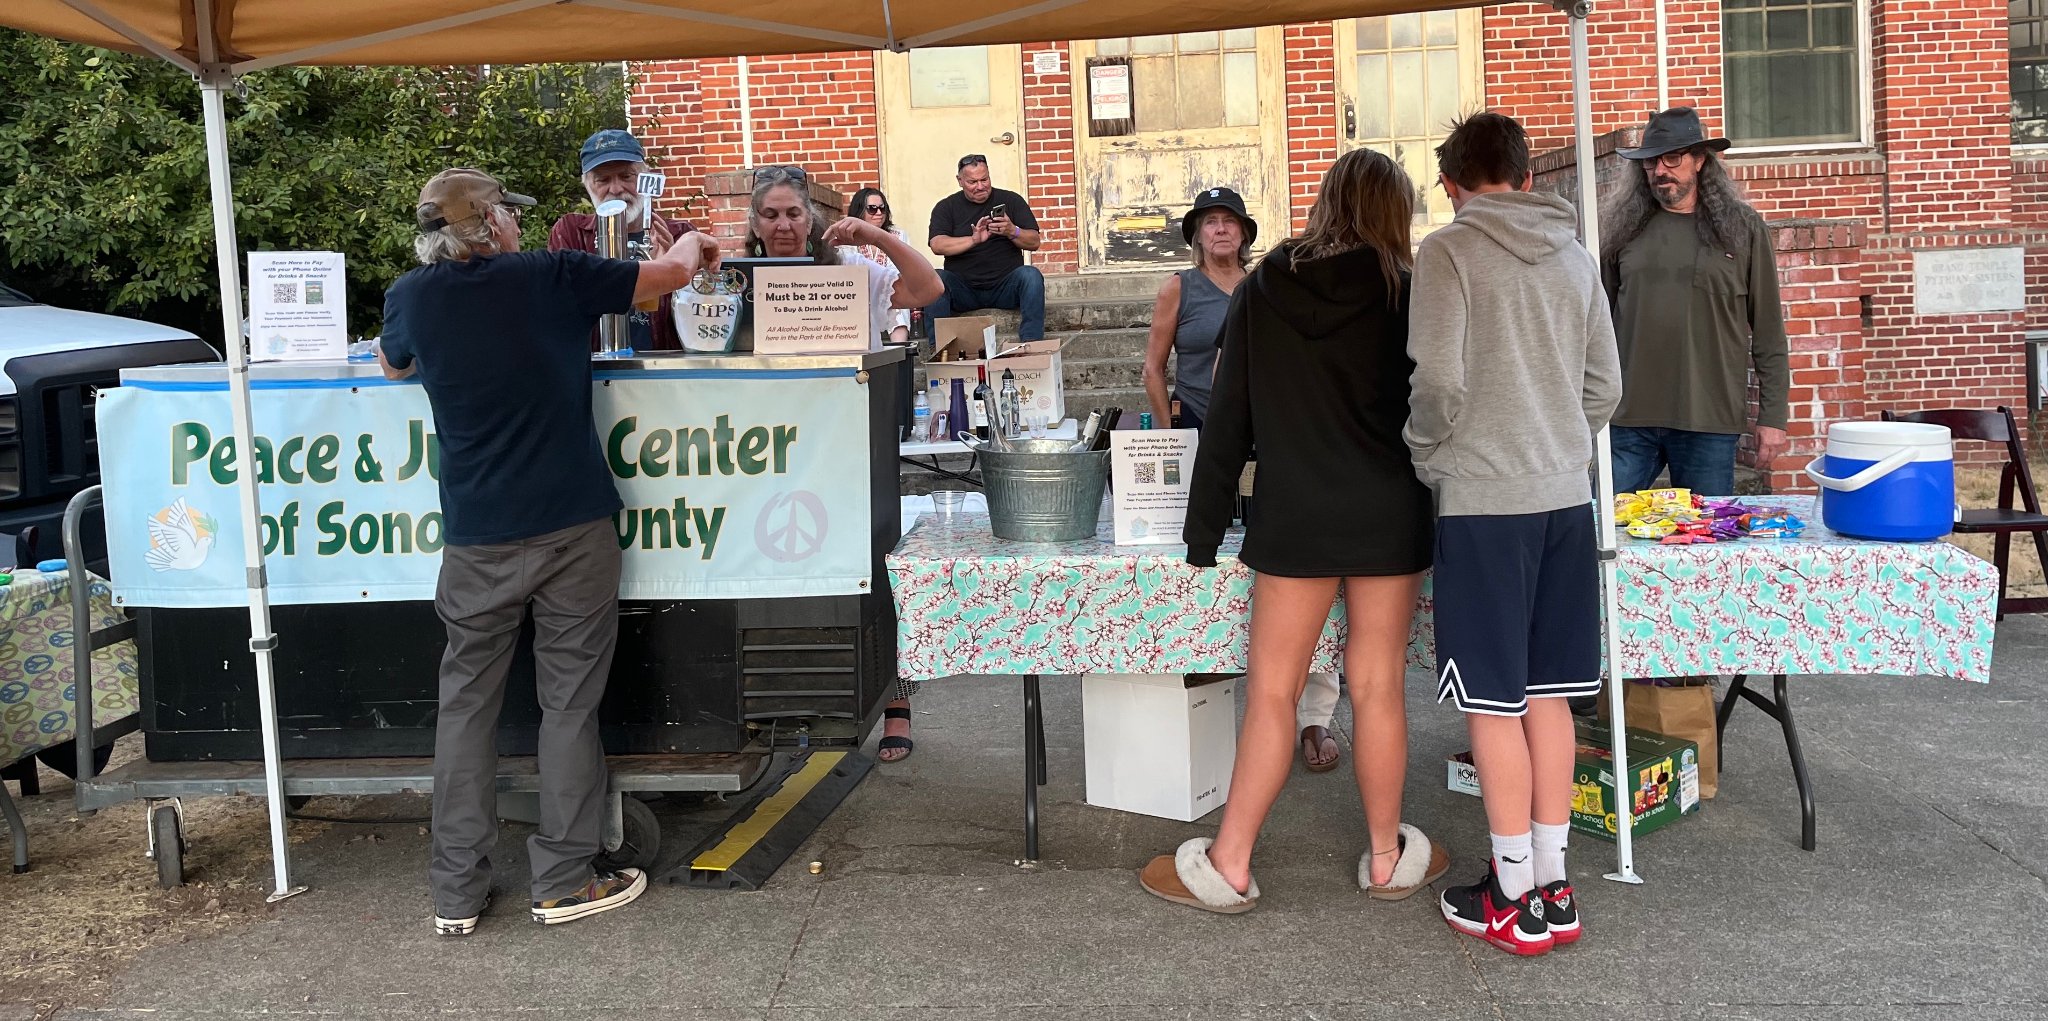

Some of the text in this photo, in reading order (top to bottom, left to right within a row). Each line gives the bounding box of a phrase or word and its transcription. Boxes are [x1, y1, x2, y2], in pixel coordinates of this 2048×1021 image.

[638, 176, 661, 195] IPA
[766, 292, 790, 301] Must
[793, 292, 806, 301] be
[692, 302, 735, 317] TIPS
[172, 422, 340, 485] Peace
[354, 433, 384, 483] &
[607, 414, 797, 479] Center
[260, 496, 726, 560] of Sono unty
[1583, 814, 1604, 826] school
